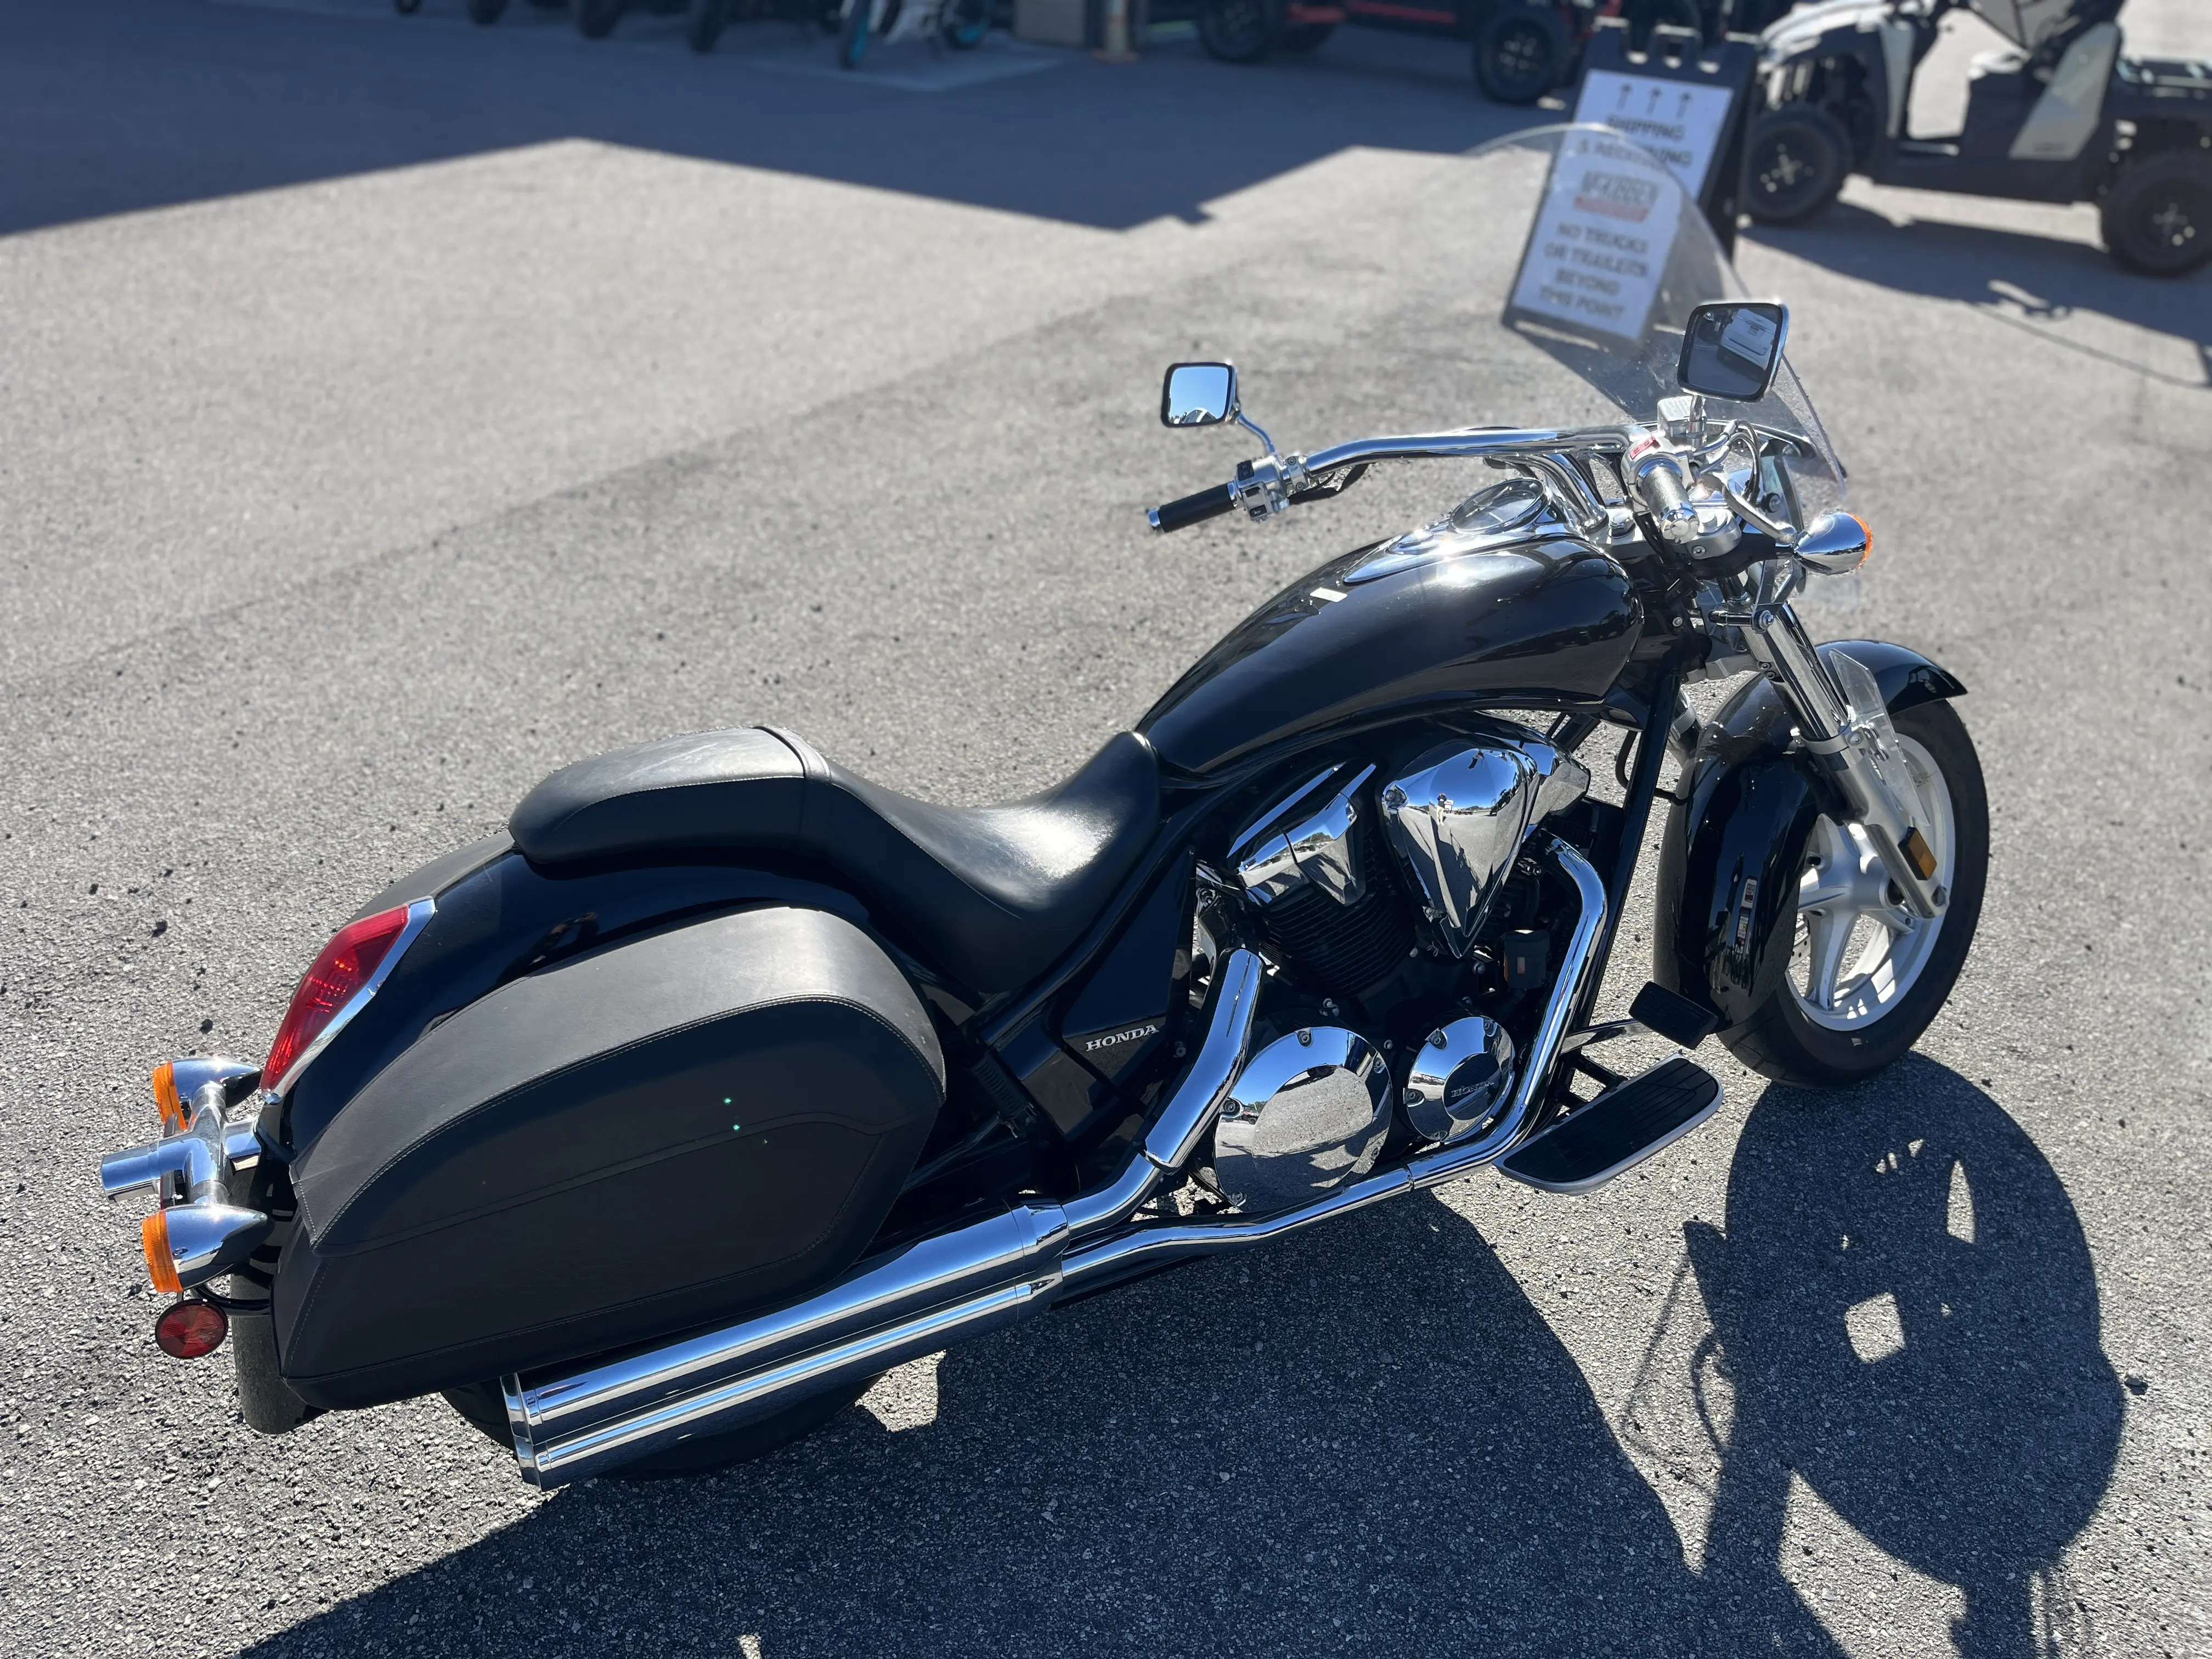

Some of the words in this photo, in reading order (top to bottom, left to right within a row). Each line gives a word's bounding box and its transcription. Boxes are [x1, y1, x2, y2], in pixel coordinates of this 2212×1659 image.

[1606, 115, 1685, 140] SHIPPING
[1557, 222, 1582, 240] NO
[1585, 227, 1649, 255] TRUCKS
[1544, 242, 1568, 261] OR
[1571, 247, 1649, 278] TRAILERS
[1555, 267, 1621, 297] BEYOND
[1539, 285, 1573, 308] THIS
[1575, 295, 1625, 321] POINT
[1086, 1024, 1159, 1052] HONDA
[1451, 1080, 1495, 1098] HONDA
